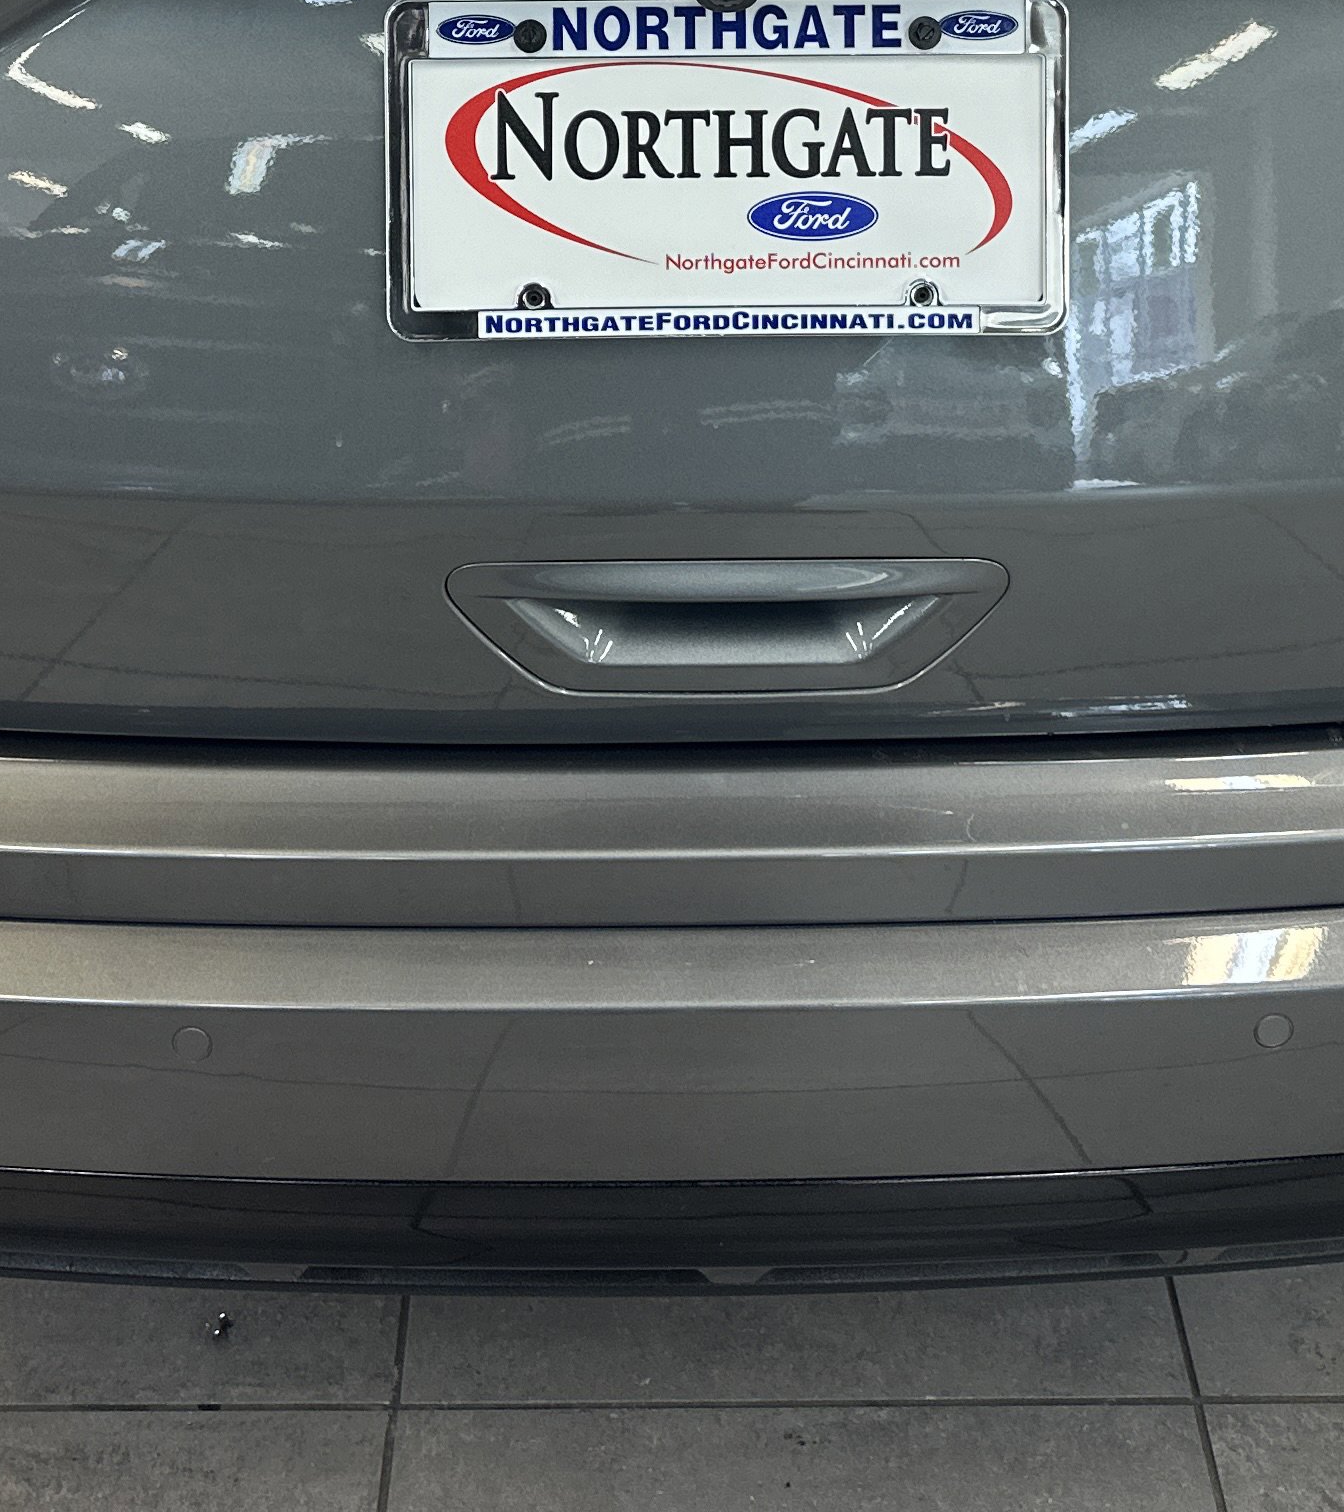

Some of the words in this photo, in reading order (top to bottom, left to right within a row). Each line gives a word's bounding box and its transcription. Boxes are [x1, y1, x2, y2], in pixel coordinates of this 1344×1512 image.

[451, 19, 500, 38] Ford
[552, 4, 902, 51] NORTHGATE
[954, 14, 1002, 34] Ford
[490, 90, 952, 181] NORTHGATE
[773, 199, 852, 230] Ford
[666, 251, 961, 274] NorthgateFordCincinnati.com
[484, 311, 974, 335] NORTHGATEFORDCINCINNATI.COM
